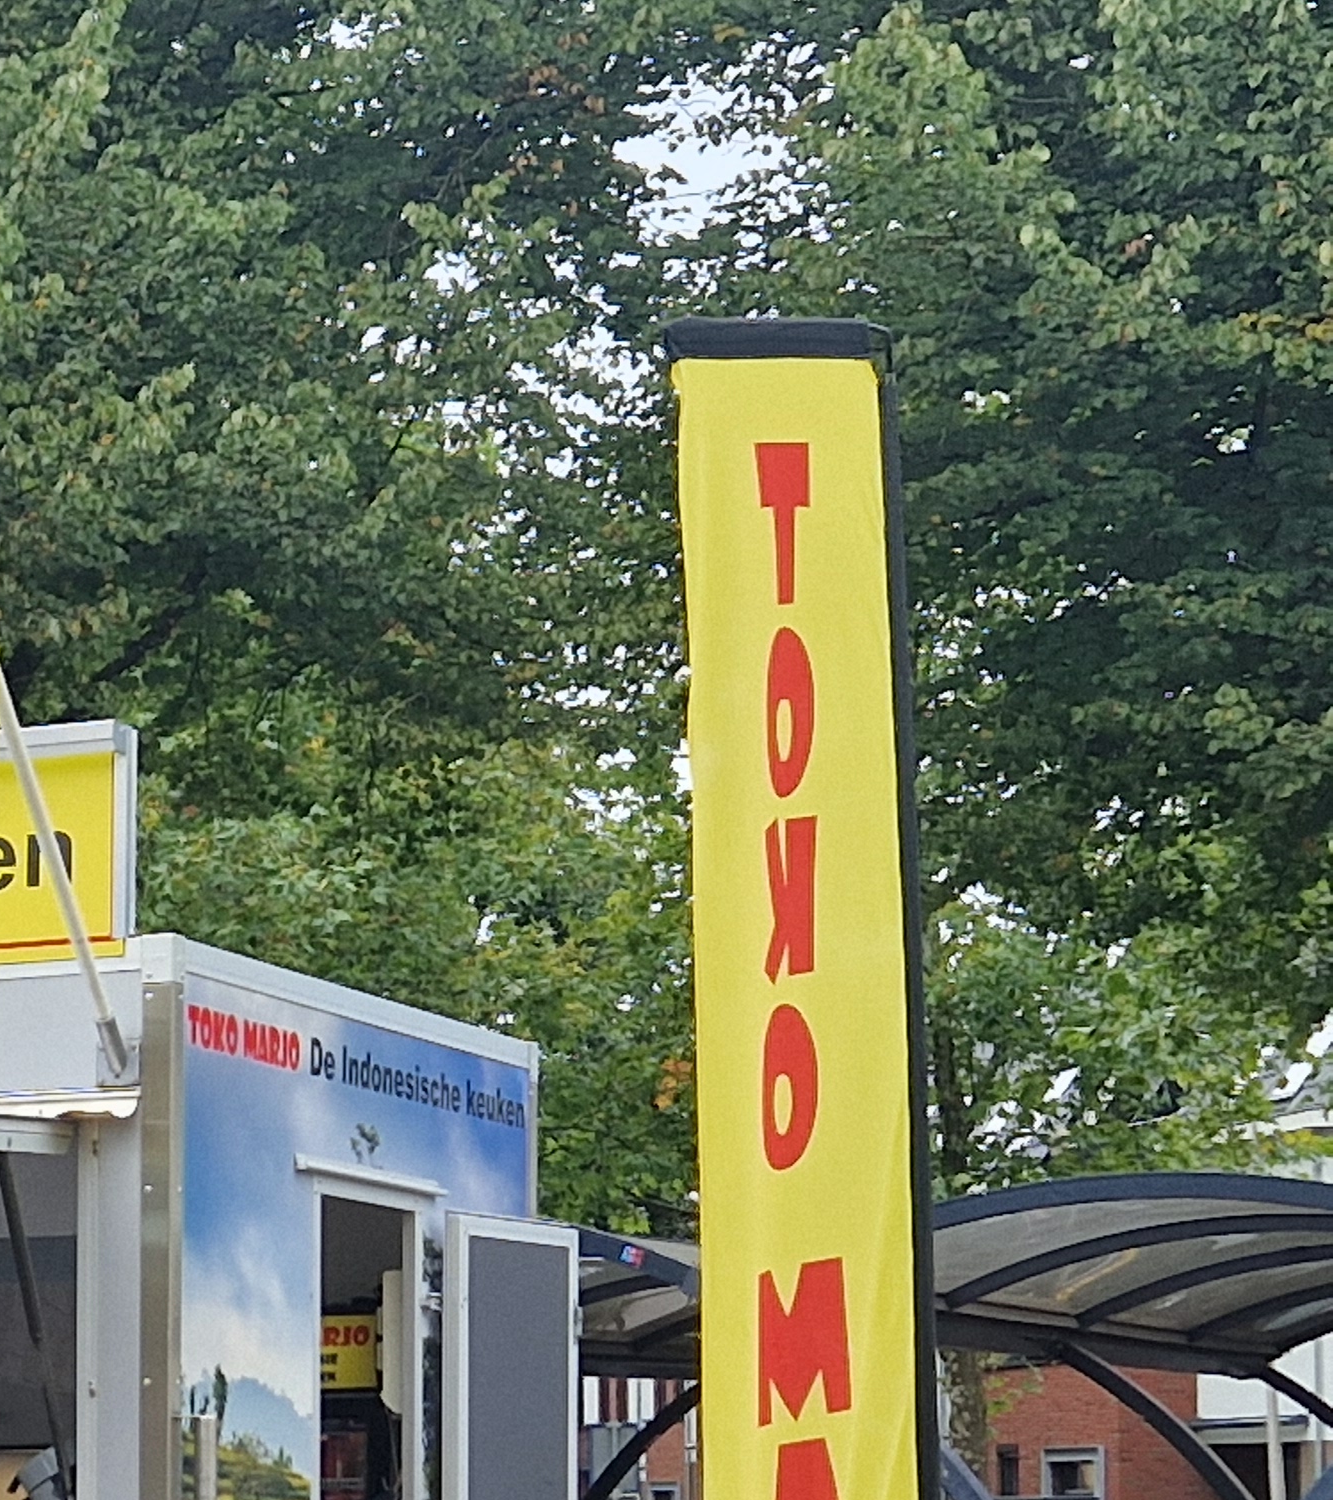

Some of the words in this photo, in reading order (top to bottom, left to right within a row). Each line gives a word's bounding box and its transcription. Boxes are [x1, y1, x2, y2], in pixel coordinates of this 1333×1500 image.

[188, 1003, 238, 1057] TOKO
[243, 1019, 300, 1071] MARJO
[309, 1036, 336, 1080] De
[342, 1046, 461, 1113] Indonesische
[465, 1079, 527, 1129] keuken
[323, 1325, 370, 1346] RJO
